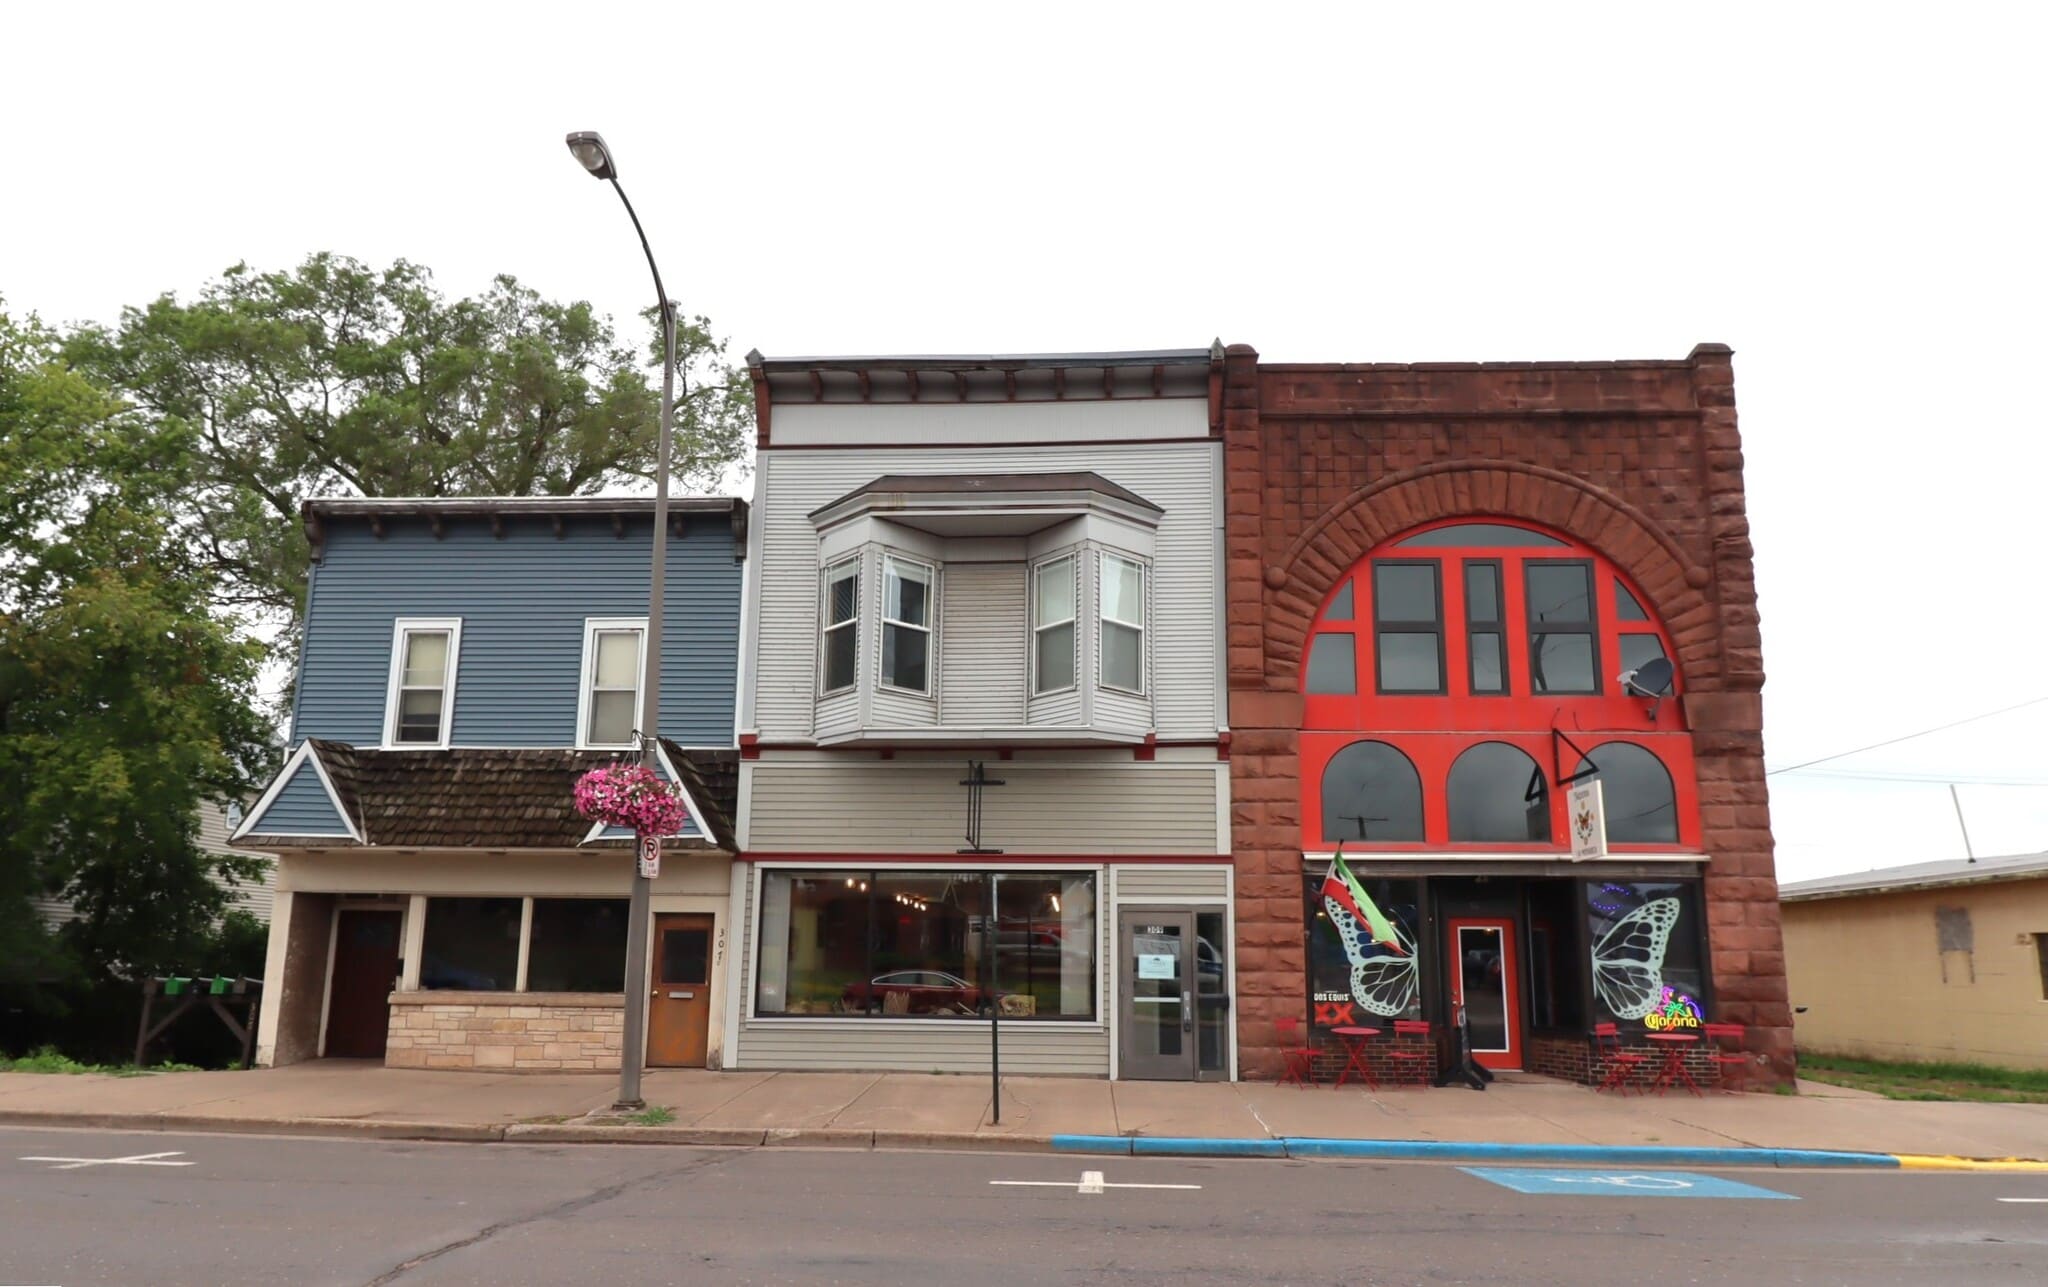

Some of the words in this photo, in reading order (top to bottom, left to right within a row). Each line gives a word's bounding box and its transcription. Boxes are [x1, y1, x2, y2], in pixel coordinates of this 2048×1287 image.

[1313, 993, 1327, 1002] DOS
[1328, 993, 1349, 1002] EQUIS
[1314, 1002, 1356, 1025] XX
[1644, 1013, 1698, 1031] Corona
